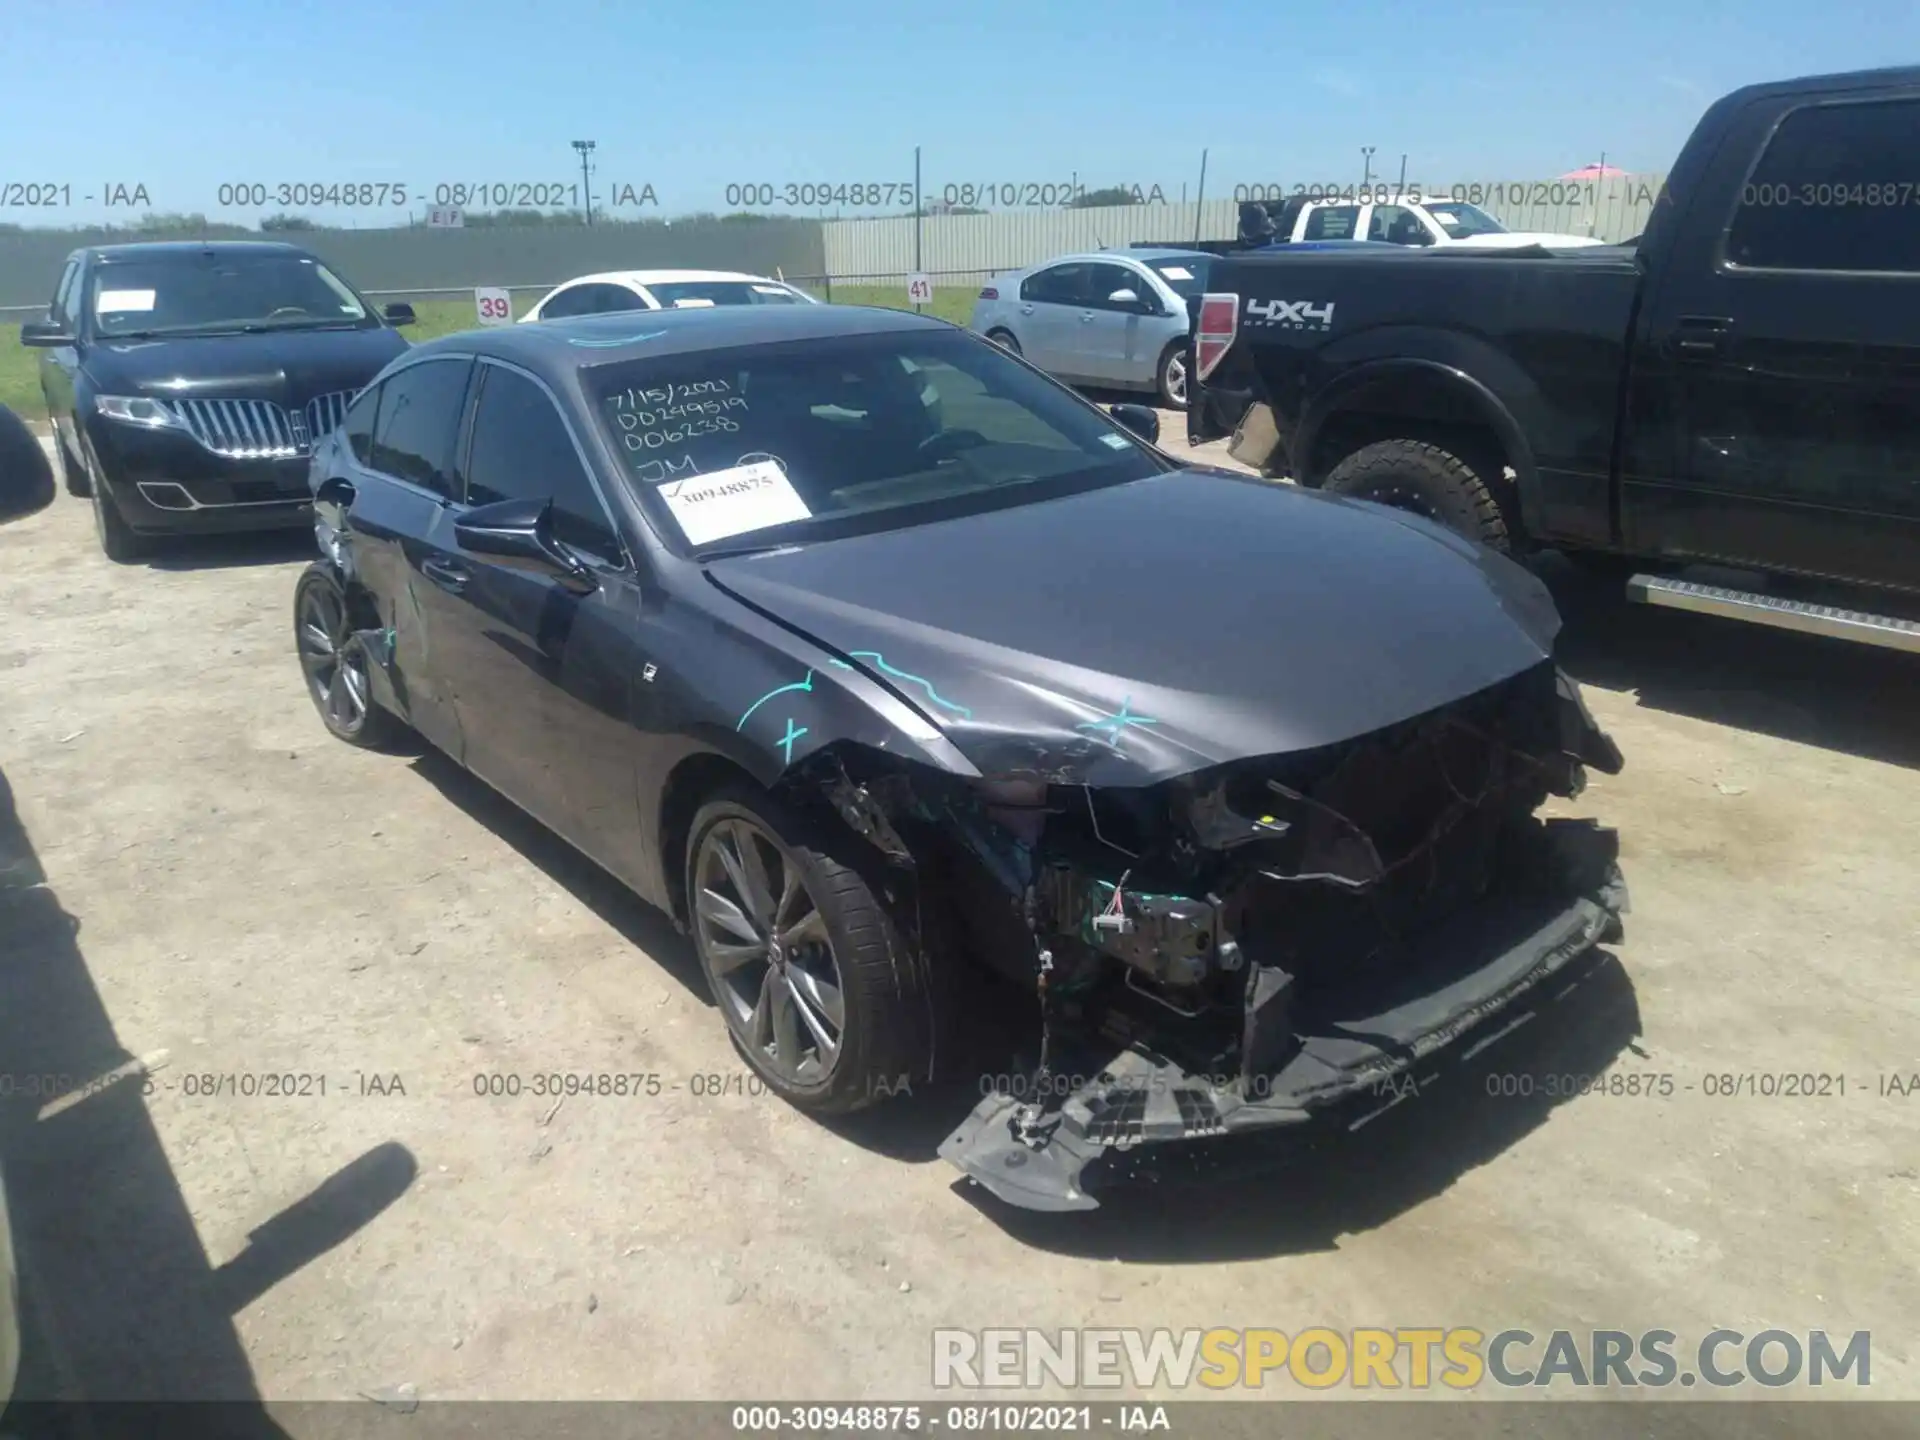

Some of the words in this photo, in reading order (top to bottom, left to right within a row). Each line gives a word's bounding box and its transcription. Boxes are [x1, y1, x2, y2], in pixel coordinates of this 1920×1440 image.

[911, 281, 929, 297] 41
[480, 298, 508, 318] 39
[1246, 298, 1335, 323] 4X4
[607, 379, 731, 409] 7/15/2021
